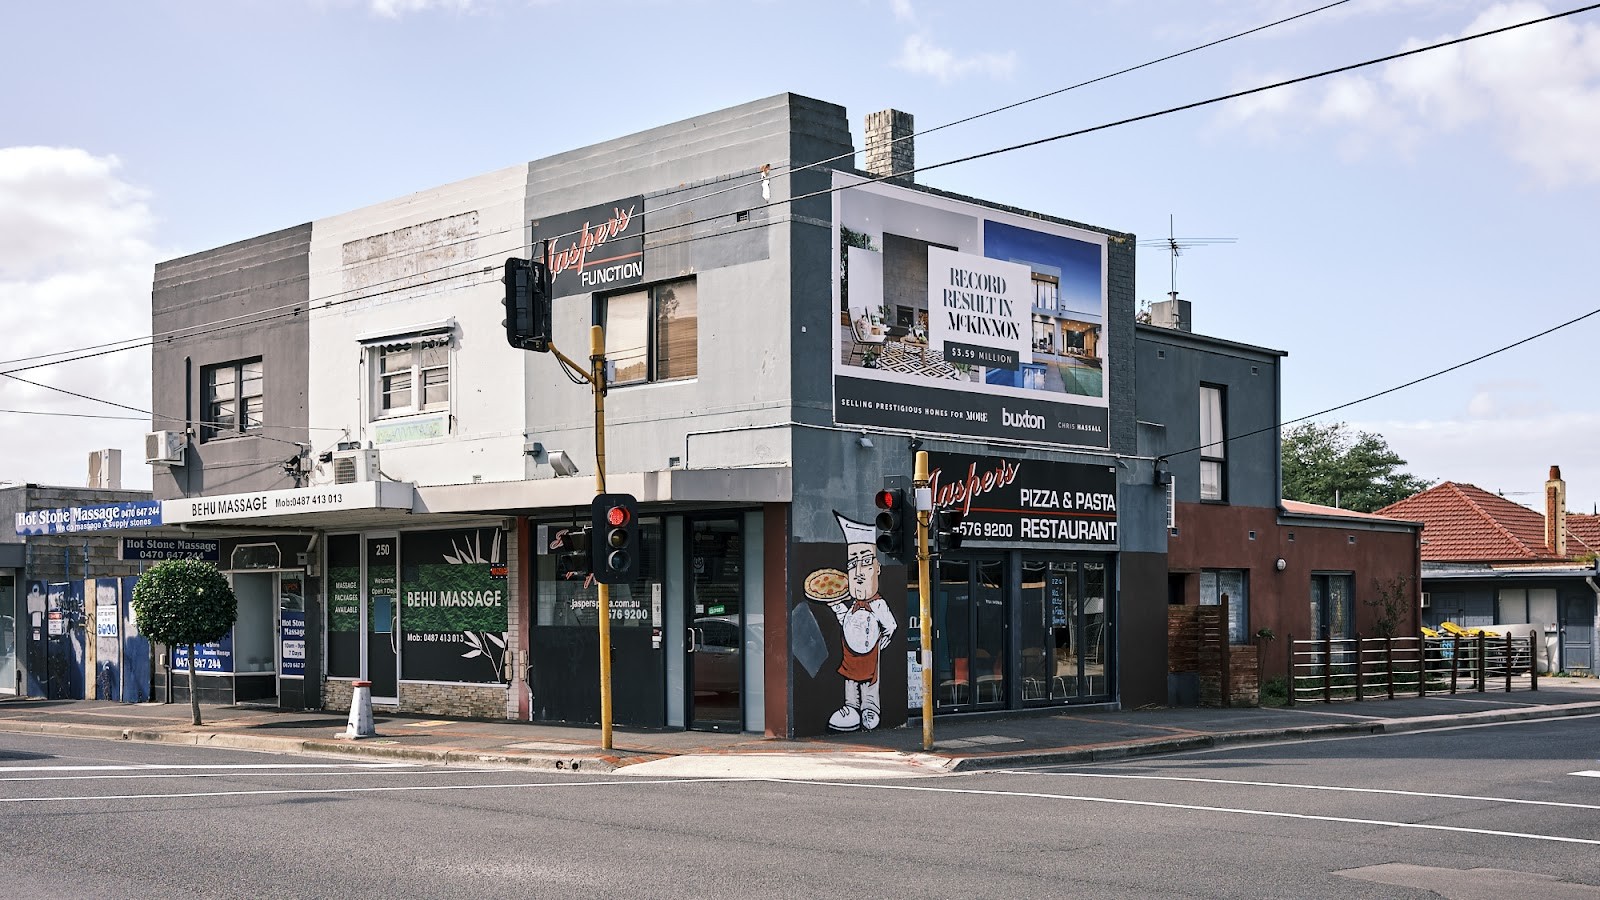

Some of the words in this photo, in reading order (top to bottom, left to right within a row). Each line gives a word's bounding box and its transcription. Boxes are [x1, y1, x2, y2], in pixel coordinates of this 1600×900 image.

[581, 261, 642, 287] FUNCTION
[950, 267, 1007, 294] RECORD
[943, 288, 997, 315] RESULT
[999, 298, 1013, 318] IN
[951, 347, 975, 358] $3.59
[978, 351, 1012, 363] MILLION
[841, 398, 873, 409] SELLING
[875, 402, 923, 414] PRESTIGIOUS
[924, 408, 948, 417] HOMES
[965, 410, 989, 422] MORE
[1002, 407, 1046, 430] buxton
[1057, 421, 1076, 430] CHRIS
[191, 501, 216, 517] BEHU
[218, 496, 267, 514] MASSAGE
[312, 494, 326, 504] 413
[328, 493, 343, 503] 013
[1020, 488, 1060, 509] PIZZA
[1062, 491, 1073, 509] &
[1075, 492, 1116, 511] PASTA
[18, 512, 37, 526] Hot
[38, 509, 70, 525] Stone
[72, 506, 120, 521] Massage
[120, 509, 135, 518] 0470
[136, 508, 147, 517] 647
[148, 506, 160, 515] 244
[102, 519, 108, 528] &
[108, 519, 129, 529] supply
[130, 518, 152, 526] stones
[983, 523, 1013, 537] 9200
[1020, 518, 1117, 541] RESTAURANT
[126, 539, 144, 549] Hot
[146, 540, 175, 549] Stone
[177, 540, 217, 552] Massage
[375, 544, 390, 556] 250
[140, 551, 164, 559] 0470
[166, 552, 184, 560] 647
[186, 552, 205, 560] 244
[407, 591, 437, 607] BEHU
[440, 590, 502, 607] MASSAGE
[624, 609, 648, 620] 9200
[407, 633, 423, 642] Mob:
[423, 633, 438, 642] 0487
[439, 634, 452, 642] 413
[452, 634, 464, 642] 013
[193, 658, 207, 668] 647
[207, 658, 221, 669] 244
